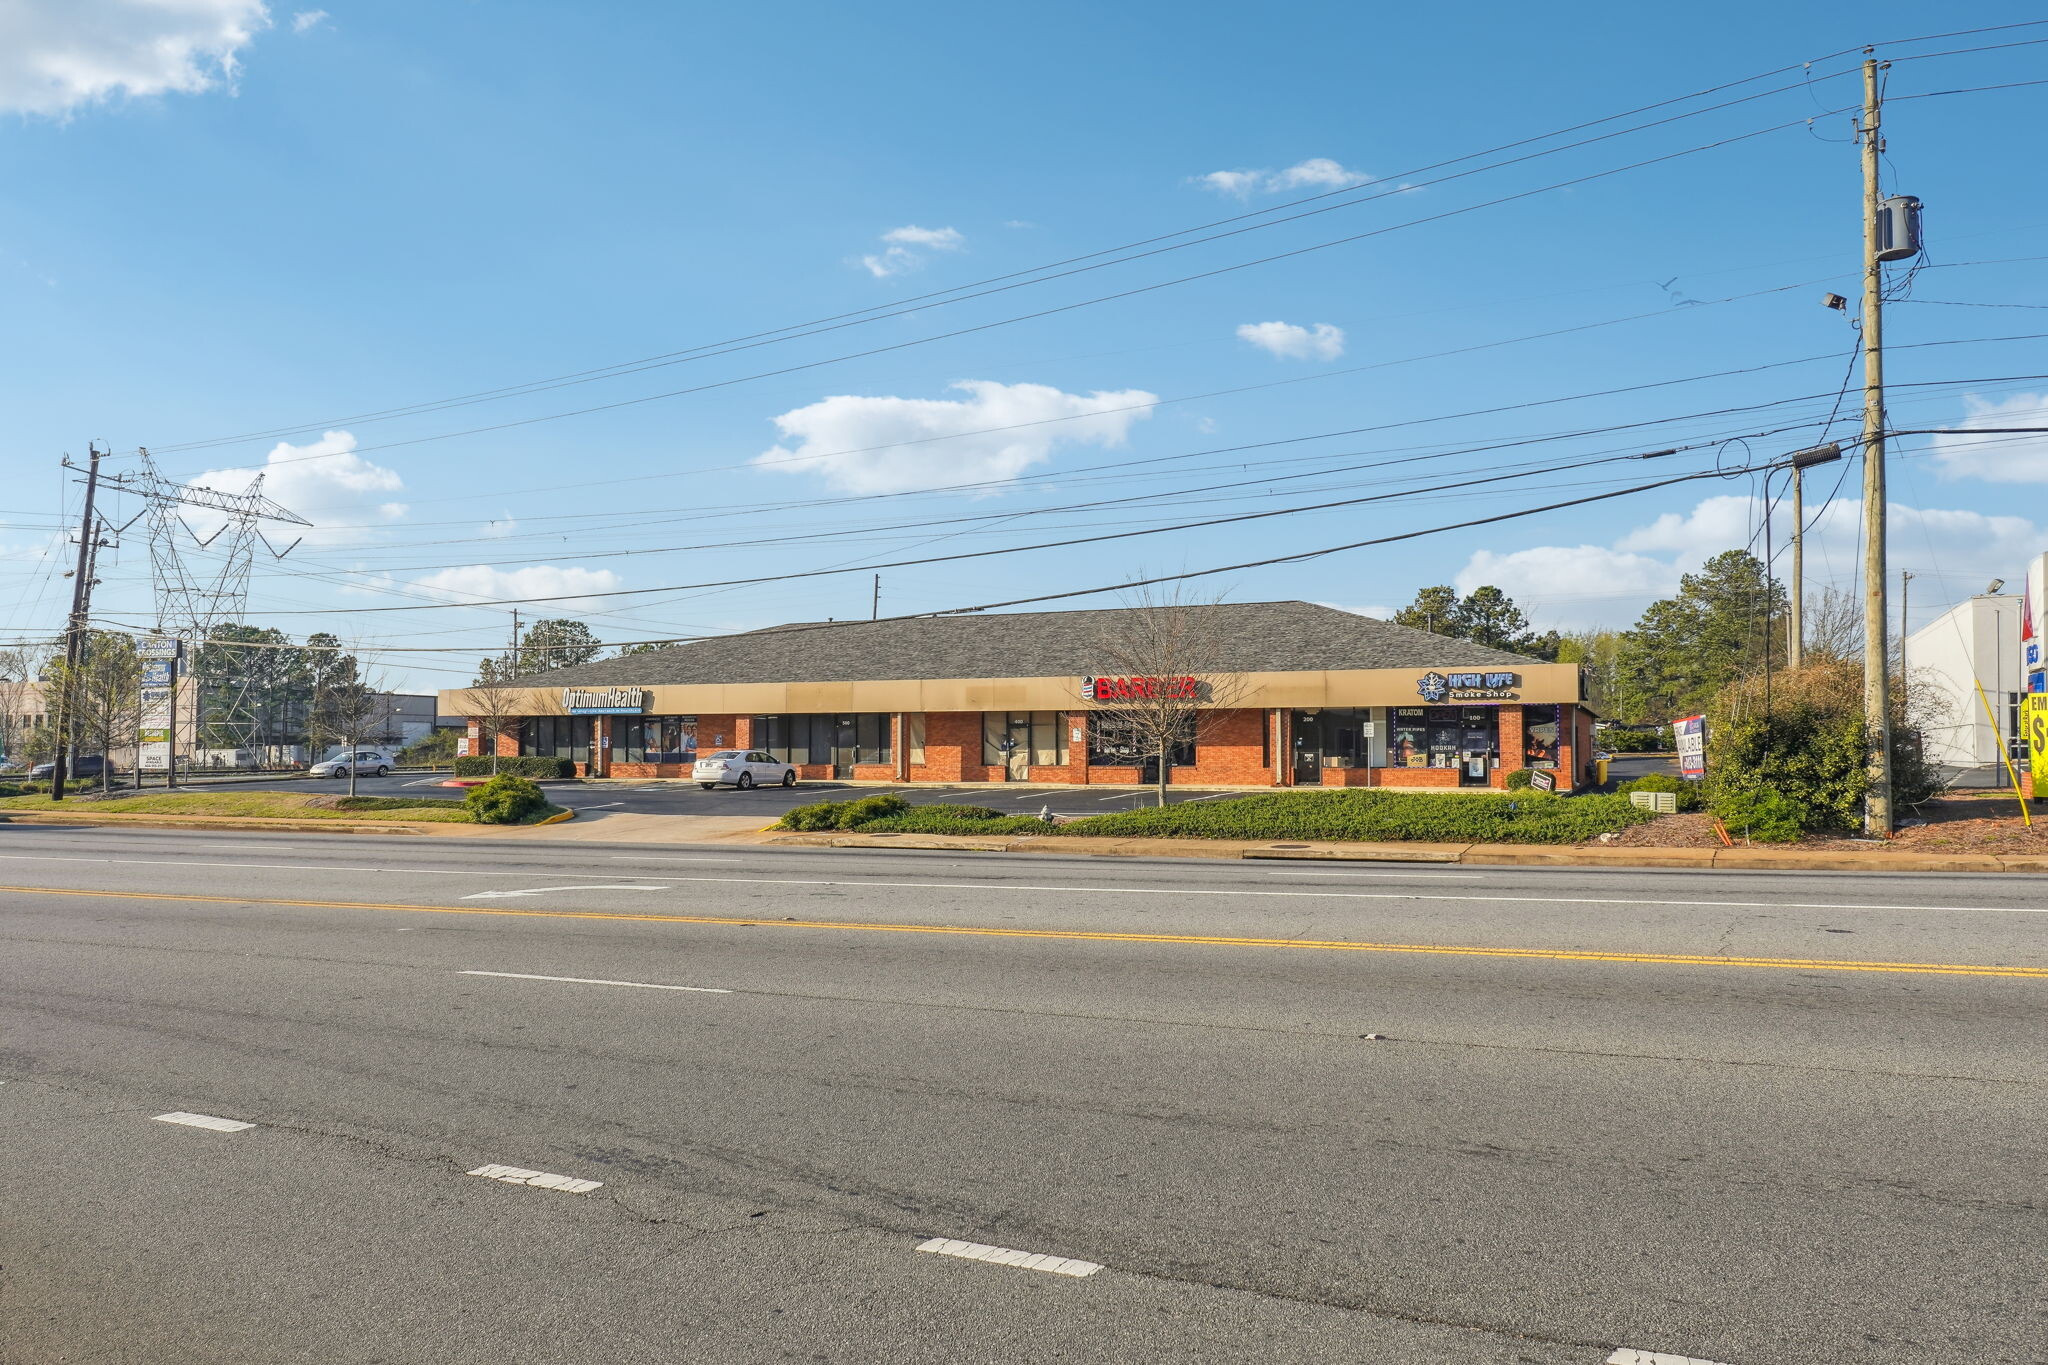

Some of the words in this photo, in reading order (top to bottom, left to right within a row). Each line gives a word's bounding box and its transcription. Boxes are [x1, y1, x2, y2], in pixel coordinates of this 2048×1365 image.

[1448, 673, 1481, 688] HIGH
[1486, 690, 1512, 698] Shop
[562, 687, 643, 713] OptimumHealth
[1398, 708, 1424, 716] KRATOM
